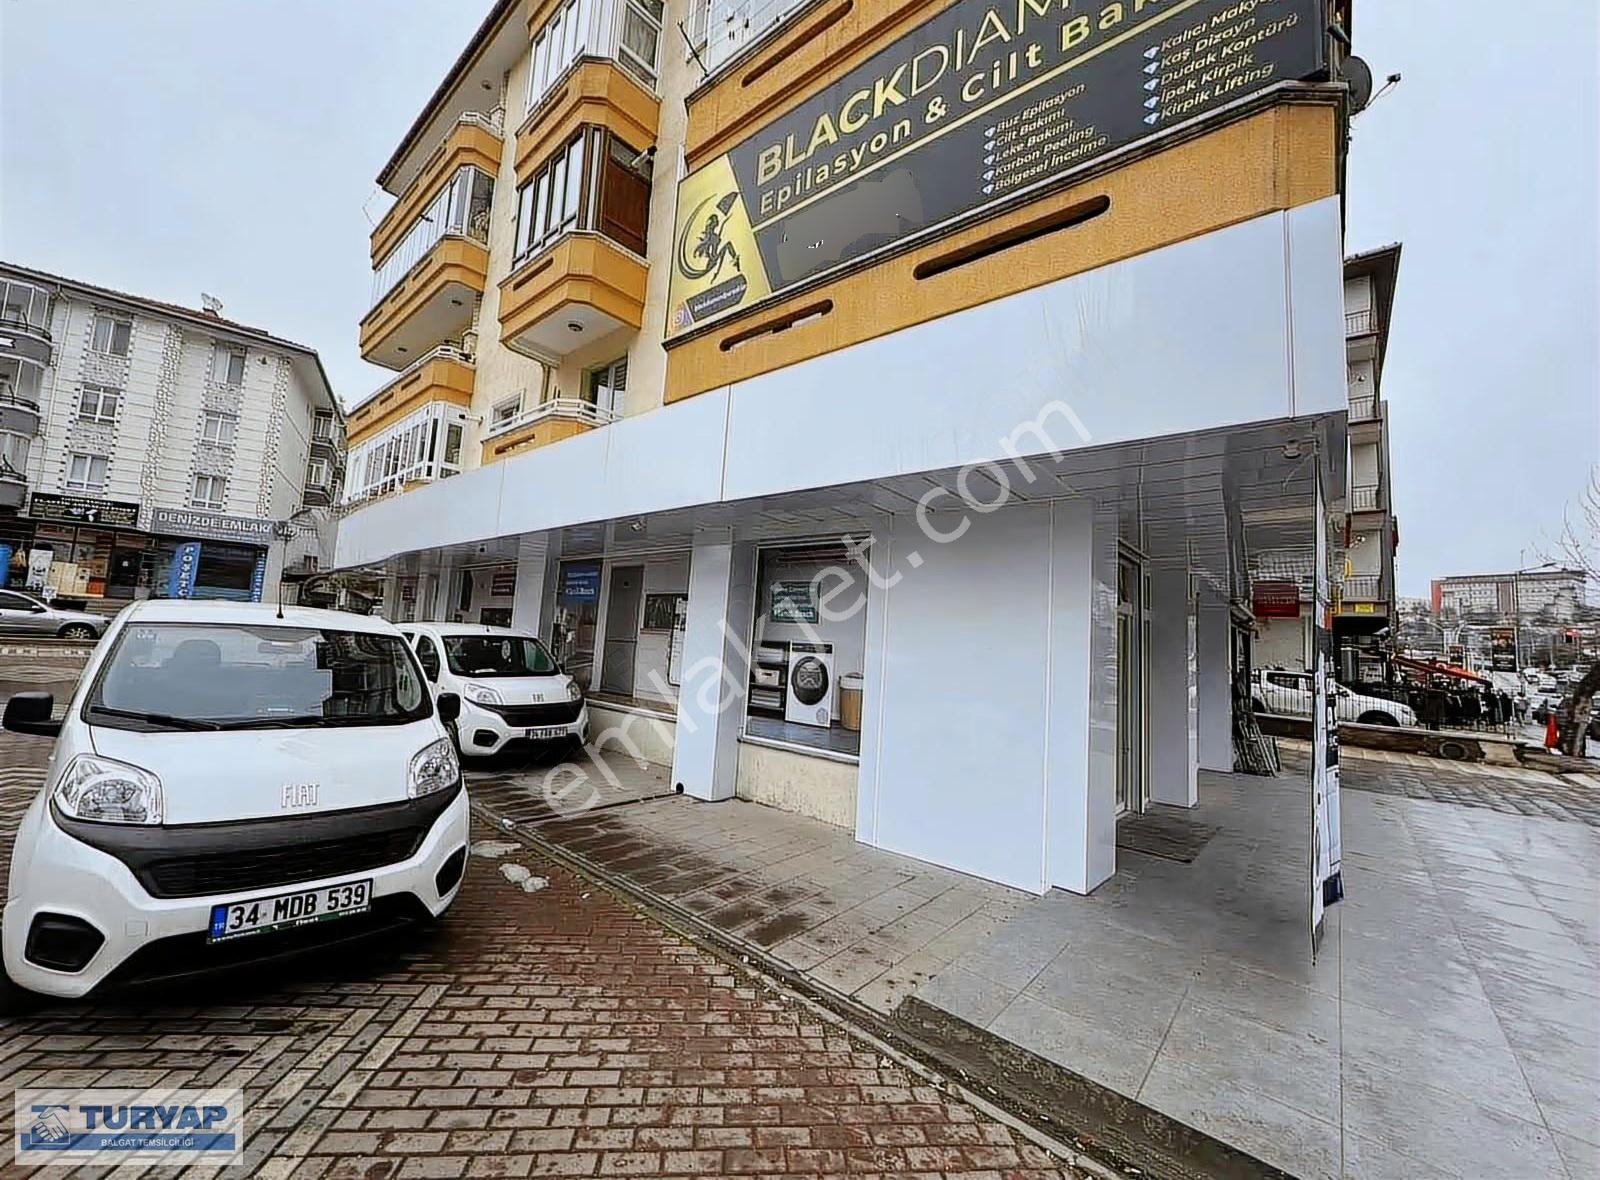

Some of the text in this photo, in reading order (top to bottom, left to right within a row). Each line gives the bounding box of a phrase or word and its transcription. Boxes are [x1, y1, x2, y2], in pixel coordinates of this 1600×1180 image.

[1161, 18, 1256, 69] Kaş Dizayn
[1161, 12, 1298, 86] Dudak Kontürü
[1161, 63, 1274, 119] Kirpik Lifting
[1201, 53, 1253, 85] Kirpik
[1022, 84, 1085, 119] Epilasyon
[760, 118, 911, 215] Epilasyon
[925, 96, 947, 124] &
[995, 126, 1095, 176] Karbon Peeling
[996, 132, 1017, 146] Cilt
[279, 783, 320, 808] FIAT
[229, 903, 260, 930] 34
[273, 893, 317, 921] MDB
[327, 885, 366, 911] 539
